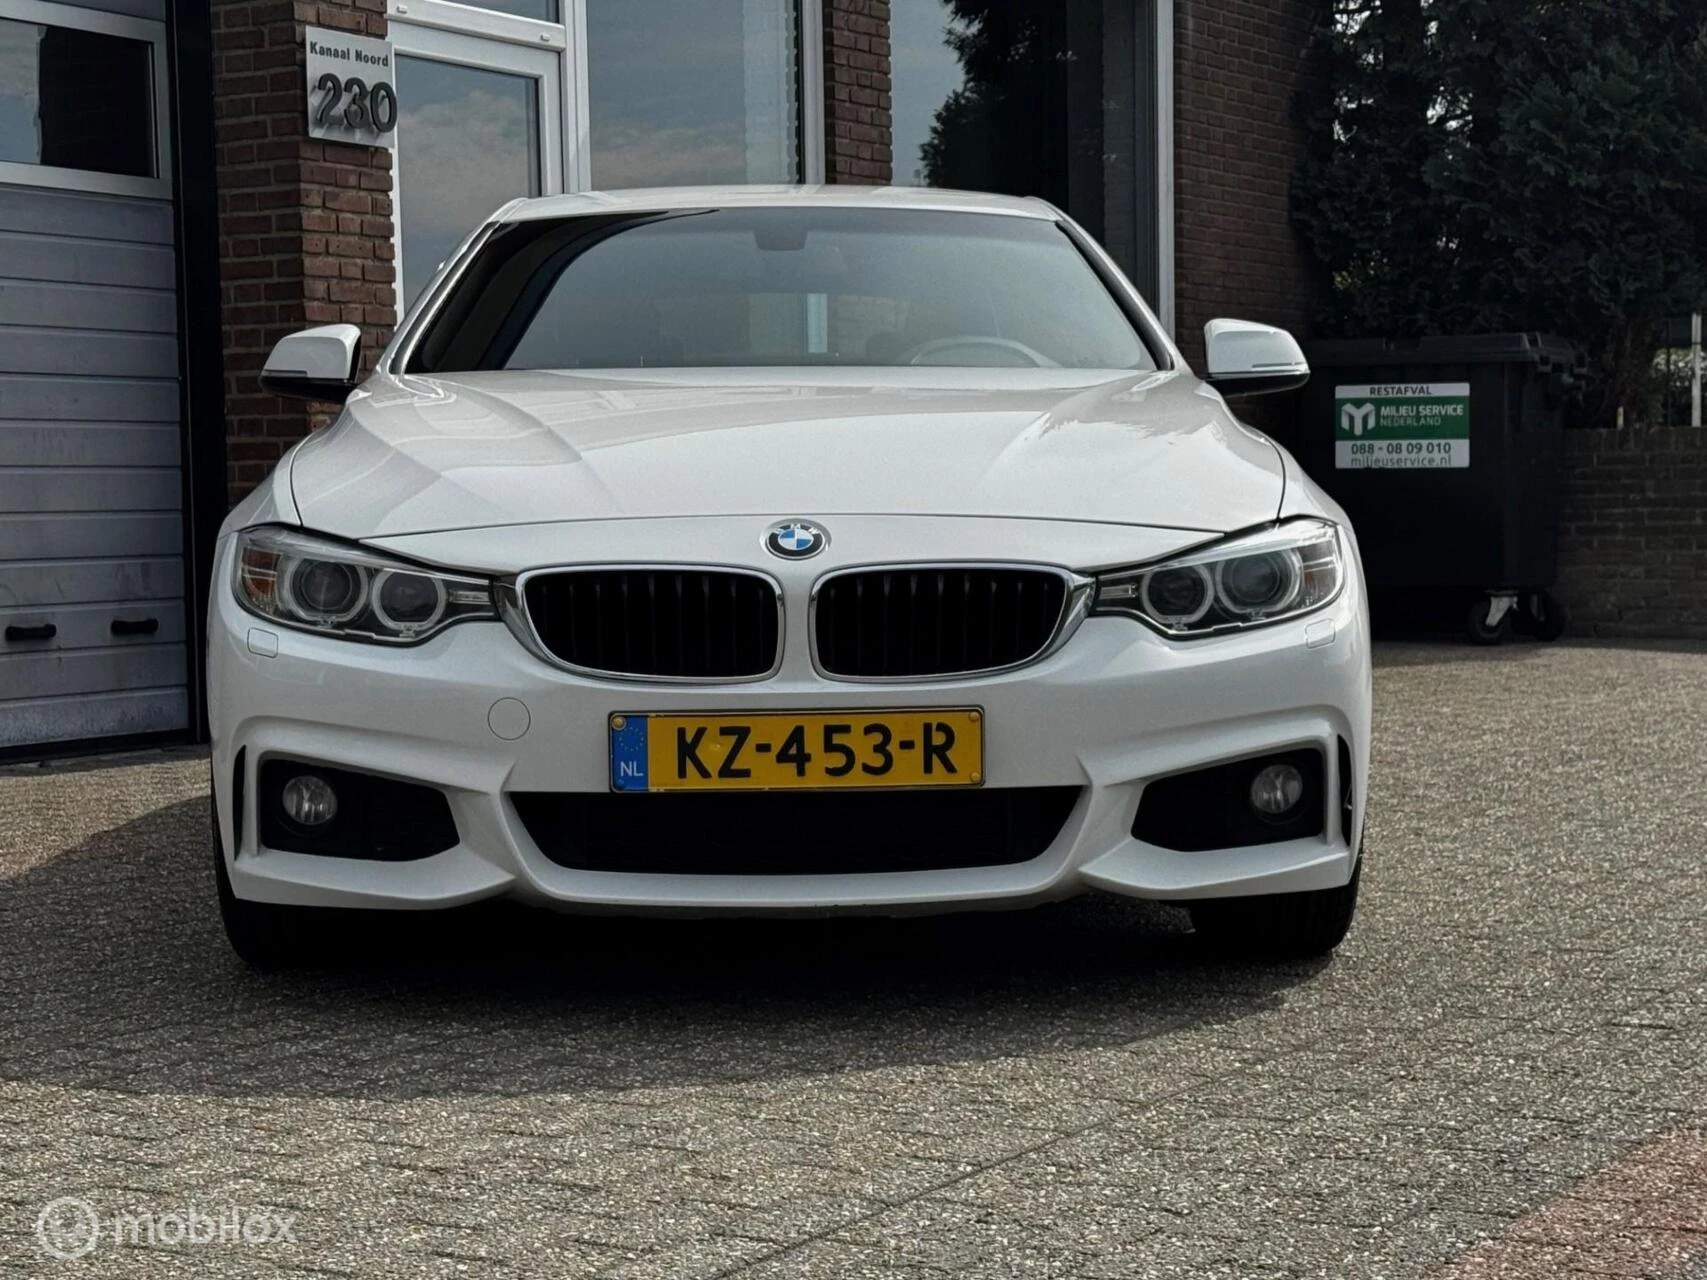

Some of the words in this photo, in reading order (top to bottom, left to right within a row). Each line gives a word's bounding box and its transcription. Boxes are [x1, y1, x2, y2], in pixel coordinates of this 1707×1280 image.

[310, 41, 350, 61] Kanaal
[355, 49, 389, 67] Noord
[318, 73, 397, 133] 230
[1369, 386, 1432, 396] RESTAFVAL
[1419, 404, 1464, 416] SERVICE
[1380, 416, 1441, 427] NEDERLAND
[1351, 443, 1375, 455] 088
[1386, 443, 1402, 454] 08
[1406, 442, 1423, 454] 09
[1426, 442, 1452, 454] 010
[677, 722, 957, 779] KZ-453-R
[619, 761, 644, 777] NL
